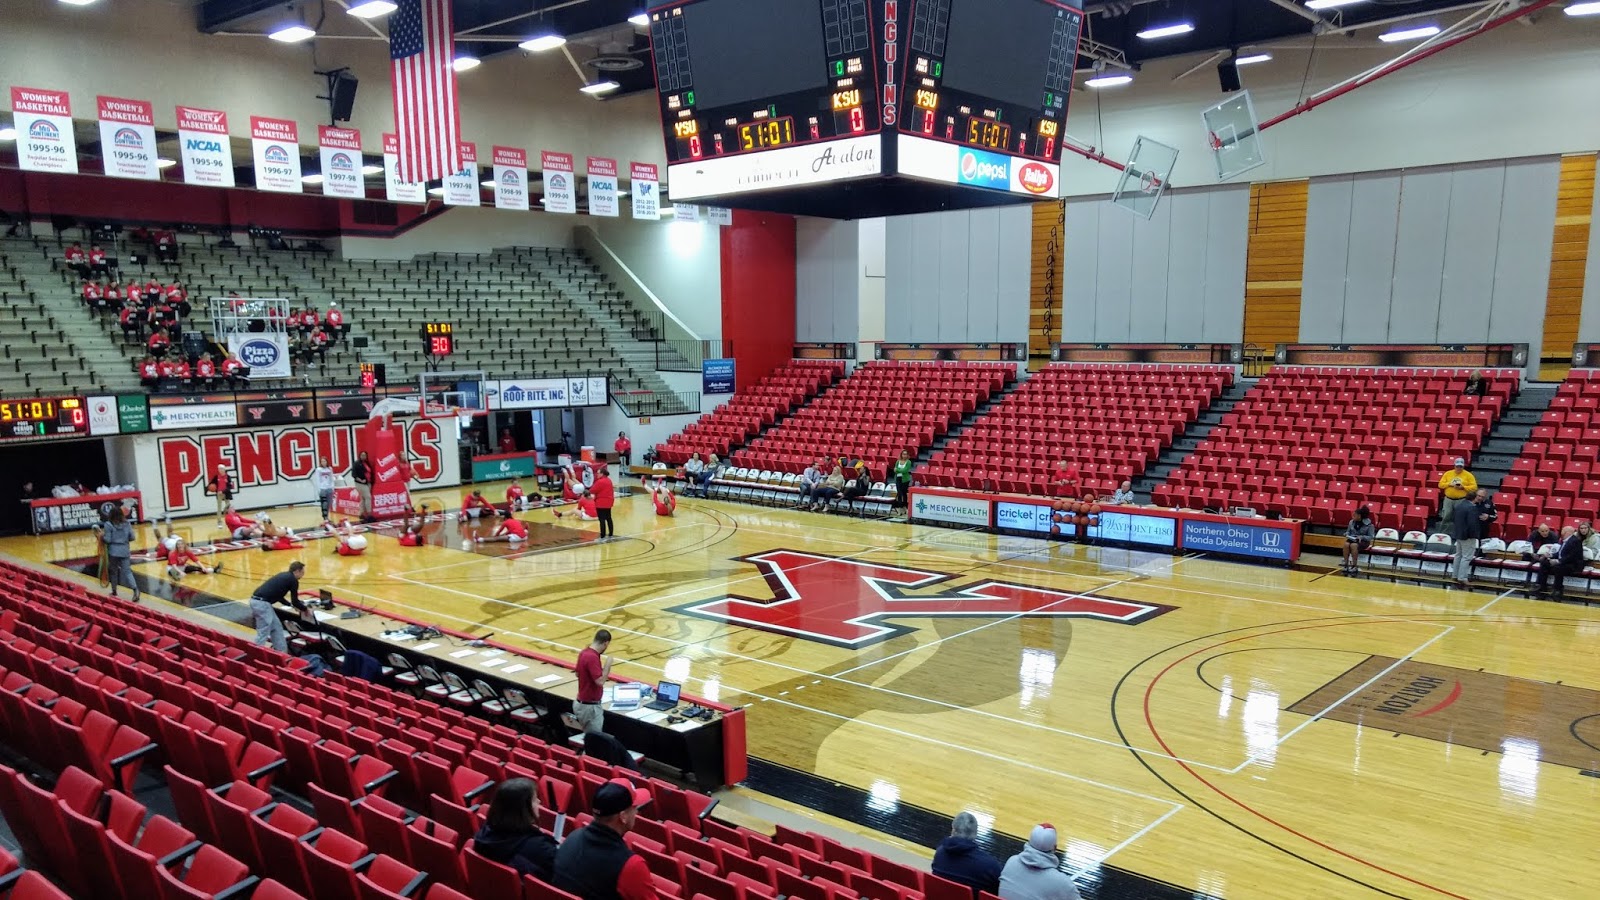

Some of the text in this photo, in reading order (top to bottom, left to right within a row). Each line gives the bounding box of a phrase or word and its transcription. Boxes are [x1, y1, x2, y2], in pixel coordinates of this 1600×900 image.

[848, 57, 860, 65] TEAM
[836, 60, 843, 75] 0
[935, 63, 942, 76] 0
[21, 92, 60, 104] WOMEN'S
[688, 92, 694, 104] 0
[833, 89, 860, 108] KSU
[917, 89, 938, 108] YSU
[1047, 94, 1052, 106] 0
[16, 101, 68, 114] BASKETBALL
[106, 101, 143, 113] WOMEN'S
[101, 110, 150, 123] BASKETBALL
[184, 111, 219, 122] WOMEN'S
[851, 107, 863, 131] 0
[924, 110, 934, 133] 0
[180, 120, 226, 132] BASKETBALL
[258, 121, 289, 131] WOMEN'S
[675, 120, 697, 136] YSU
[811, 125, 819, 139] 4
[1040, 120, 1058, 136] KSU
[254, 130, 296, 140] BASKETBALL
[326, 130, 355, 139] WOMEN'S
[742, 120, 791, 149] 51:01
[970, 120, 1008, 149] 51:01
[28, 143, 65, 154] 1995-96
[187, 139, 222, 152] NCAA
[321, 138, 359, 148] BASKETBALL
[690, 136, 700, 157] 0
[1045, 137, 1054, 157] 0
[113, 151, 148, 161] 1995-96
[498, 150, 520, 158] WOMEN'S
[547, 155, 568, 163] WOMEN'S
[191, 157, 223, 167] 1995-96
[495, 157, 525, 166] BASKETBALL
[544, 162, 572, 170] BASKETBALL
[264, 166, 292, 175] 1996-97
[589, 167, 615, 175] BASKETBALL
[635, 165, 654, 173] WOMEN'S
[977, 162, 1007, 180] pepsi
[329, 173, 356, 182] 1997-98
[632, 172, 656, 180] BASKETBALL
[1024, 168, 1048, 186] Rally's
[592, 181, 612, 190] NCAA
[245, 346, 274, 355] Pizza
[432, 337, 448, 352] 30
[247, 354, 274, 363] Joe's
[1234, 351, 1239, 359] 3
[1515, 352, 1522, 361] 4
[1576, 352, 1582, 361] 5
[363, 372, 372, 386] 30
[504, 390, 566, 401] ROOF RITE, INC.
[62, 399, 79, 408] KSU
[1, 402, 53, 420] 51:01
[73, 409, 83, 424] 0
[170, 411, 235, 421] MERCYHEALTH
[39, 421, 45, 434] 1
[158, 419, 443, 512] PENGUIS
[930, 504, 987, 517] MERCYHEALTH
[1000, 508, 1033, 520] cricket
[64, 518, 79, 526] PURE
[1104, 517, 1152, 533] WAYPOINT
[1154, 526, 1172, 536] 4180
[1186, 525, 1249, 539] Northern Ohio
[1185, 536, 1248, 548] Honda Dealers
[1374, 676, 1446, 714] HORIZON
